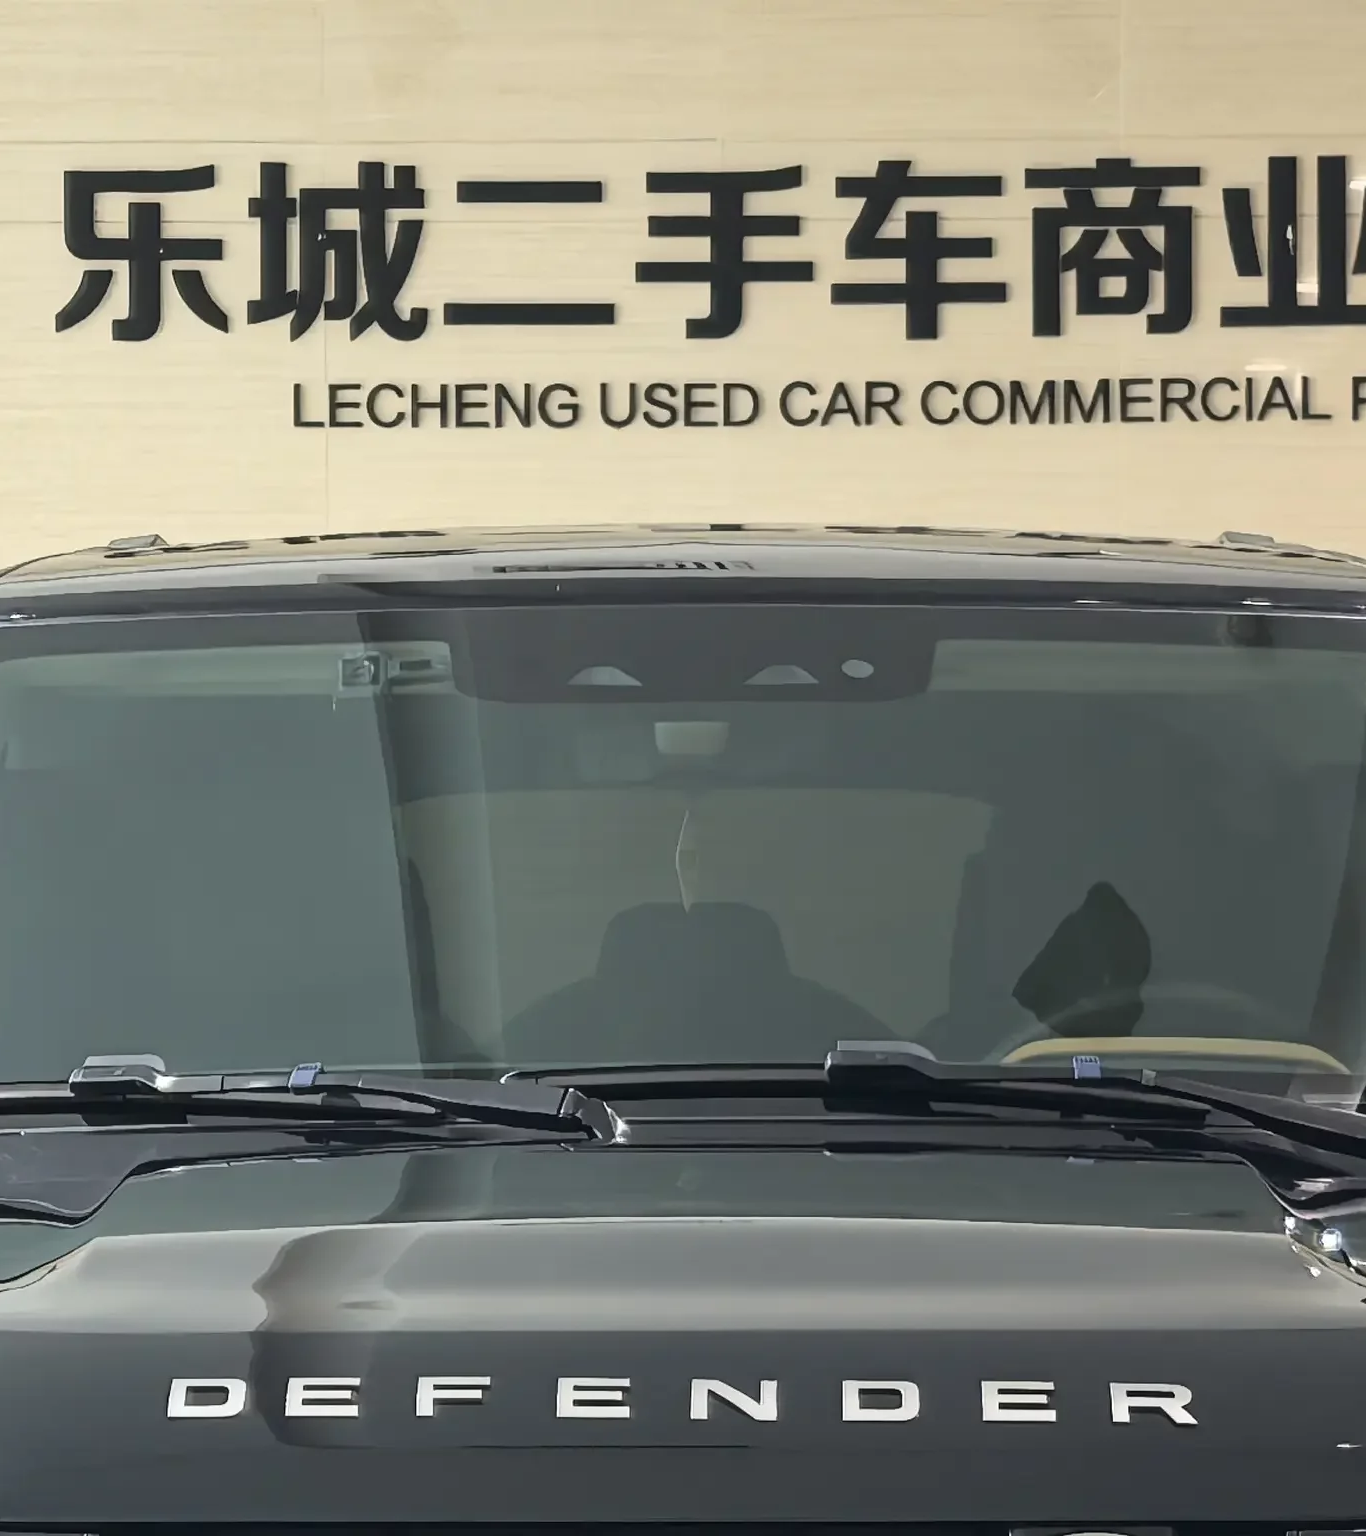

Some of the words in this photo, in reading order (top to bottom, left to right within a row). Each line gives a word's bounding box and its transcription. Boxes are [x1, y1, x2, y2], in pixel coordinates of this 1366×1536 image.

[293, 382, 581, 429] LECHENG
[599, 382, 761, 429] USED
[778, 380, 903, 428] CAR
[919, 375, 1334, 427] COMMERCIAL
[167, 1376, 1199, 1425] DEFENDER
